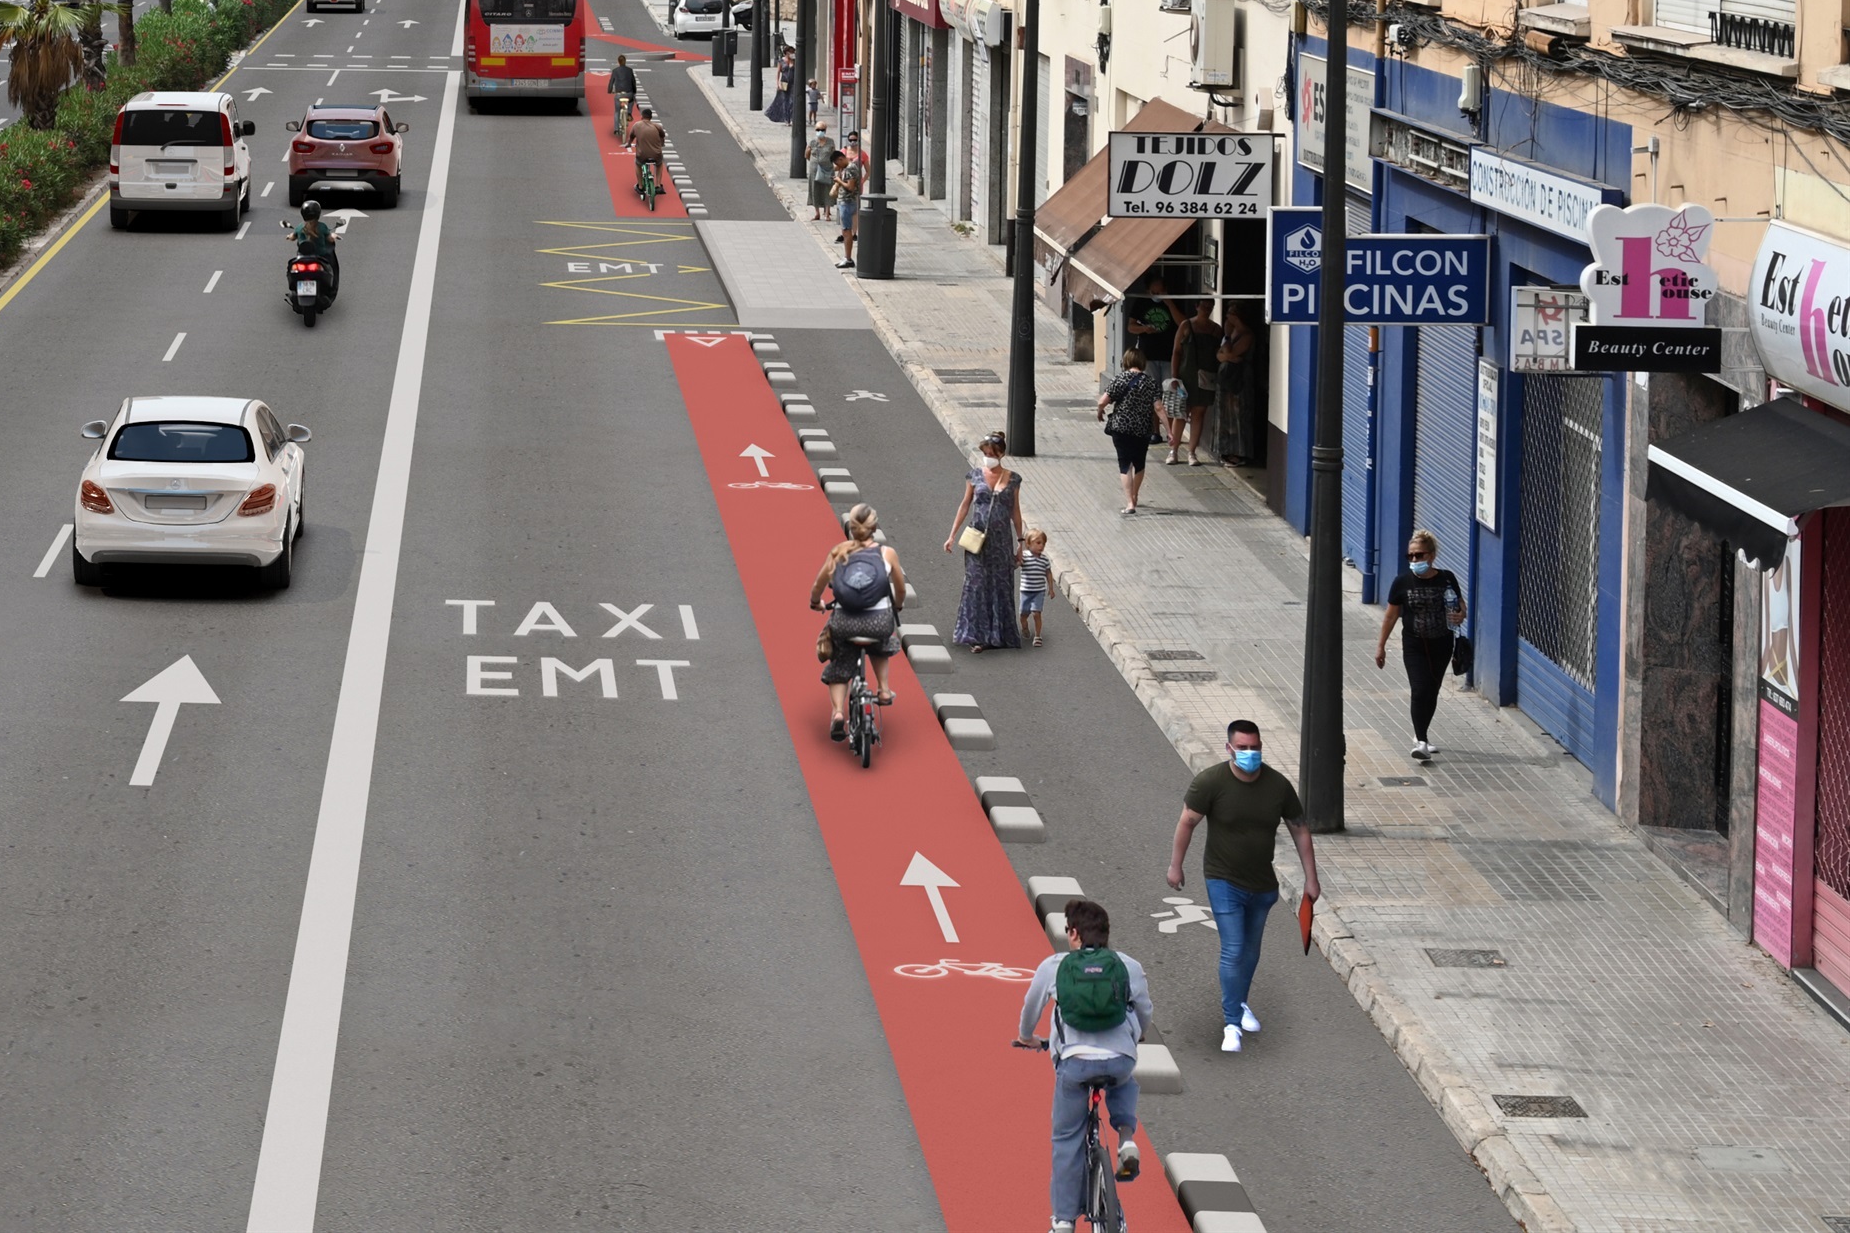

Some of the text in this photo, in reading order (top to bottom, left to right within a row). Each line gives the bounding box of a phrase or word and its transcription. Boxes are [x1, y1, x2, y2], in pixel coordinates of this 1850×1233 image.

[1132, 136, 1252, 156] TEJIDOS
[1116, 160, 1266, 196] DOLZ
[1124, 201, 1258, 215] Tel. 96 384 62 24
[1472, 160, 1599, 231] CONSTRUCCIÓN DE PISCIN
[567, 262, 664, 274] EMT
[1347, 250, 1468, 276] FILCON
[1282, 283, 1469, 316] PICINAS
[1761, 313, 1796, 337] Beauty Center
[1588, 340, 1710, 358] Beauty Center
[445, 599, 700, 640] TAXI
[466, 655, 691, 700] EMT
